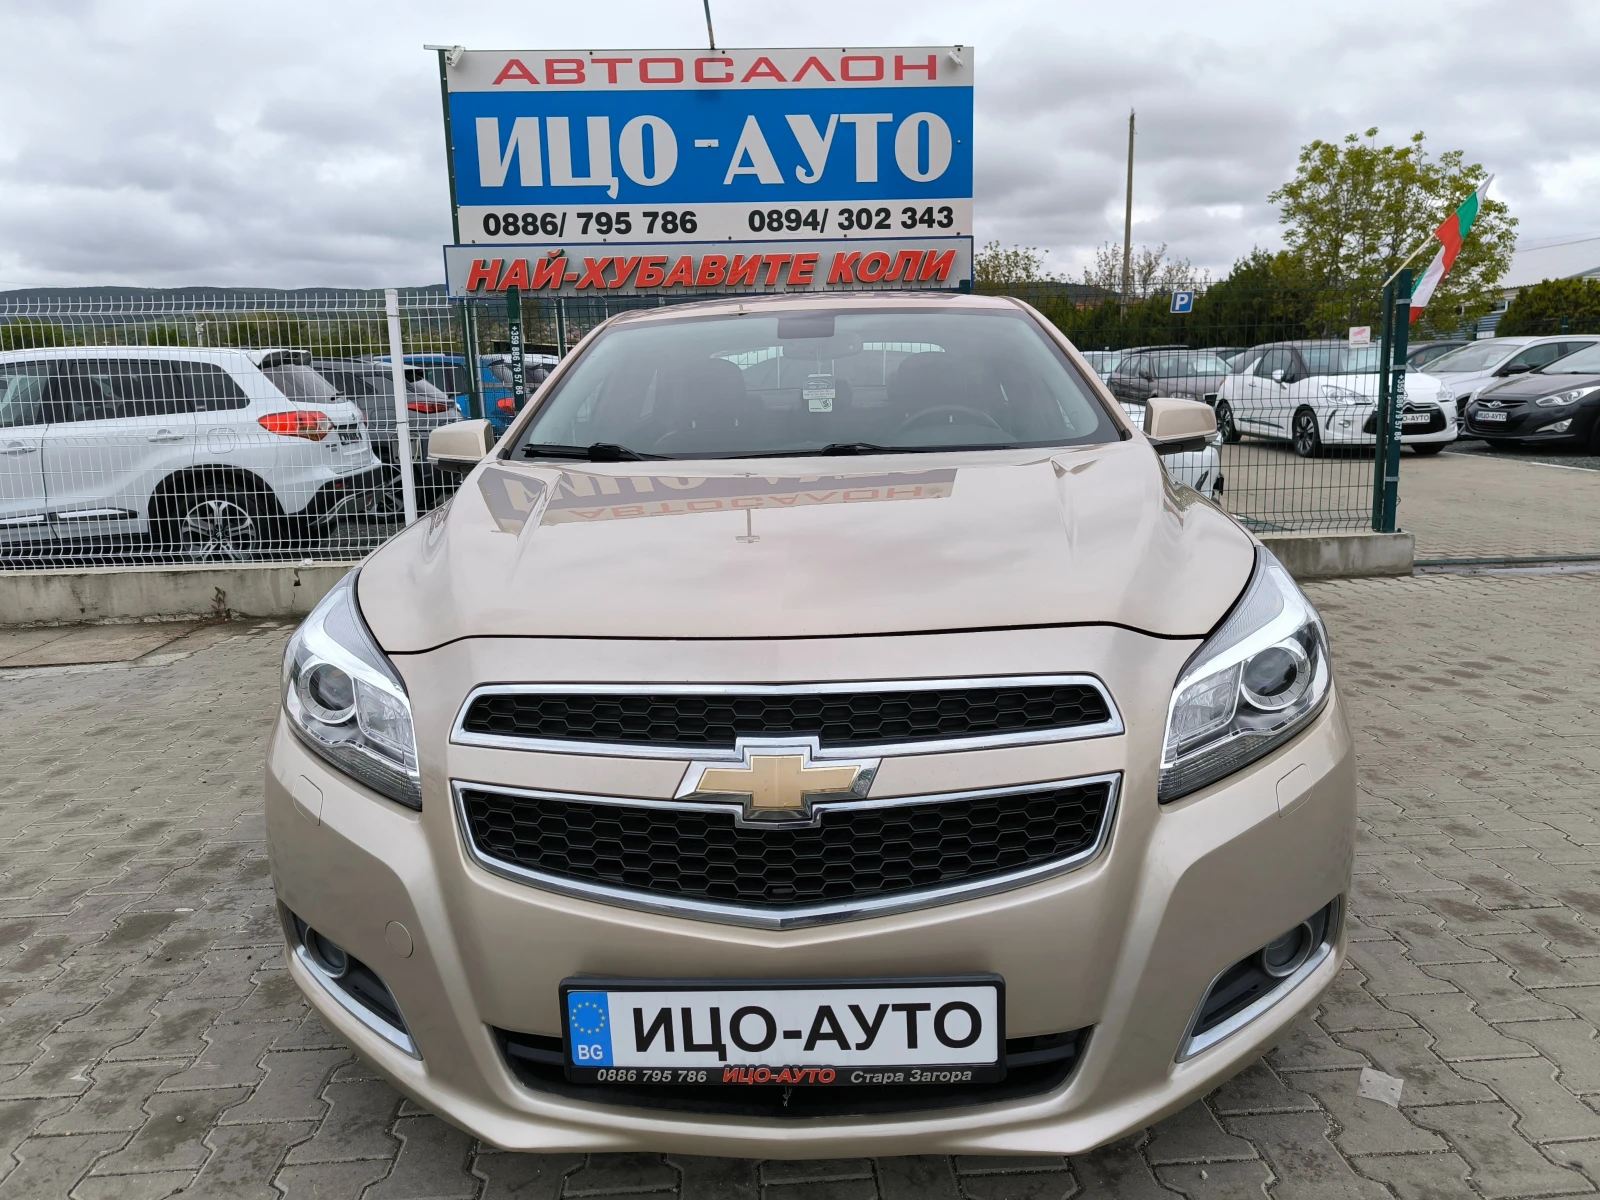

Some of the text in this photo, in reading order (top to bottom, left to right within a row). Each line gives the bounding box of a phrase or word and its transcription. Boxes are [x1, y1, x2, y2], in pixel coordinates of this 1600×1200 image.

[492, 54, 938, 86] АВТОСАЛОН
[483, 210, 698, 238] 0886/ 795 786
[747, 205, 955, 233] 0894/ 302 343
[465, 248, 957, 291] НАЙ-ХУБАВИТЕ КОЛИ
[1174, 293, 1189, 311] P
[510, 325, 524, 395] +359 886 79 57 86
[1395, 394, 1404, 408] 886
[1395, 410, 1403, 419] 79
[1402, 414, 1430, 422] О-АУТО
[1394, 421, 1403, 430] 57
[1393, 431, 1402, 441] 86
[632, 1000, 984, 1062] ИЦО-АУТО
[577, 1044, 604, 1060] BG
[596, 1066, 973, 1085] 0886 795 786 ИЦО-АУТО Стара Загора
